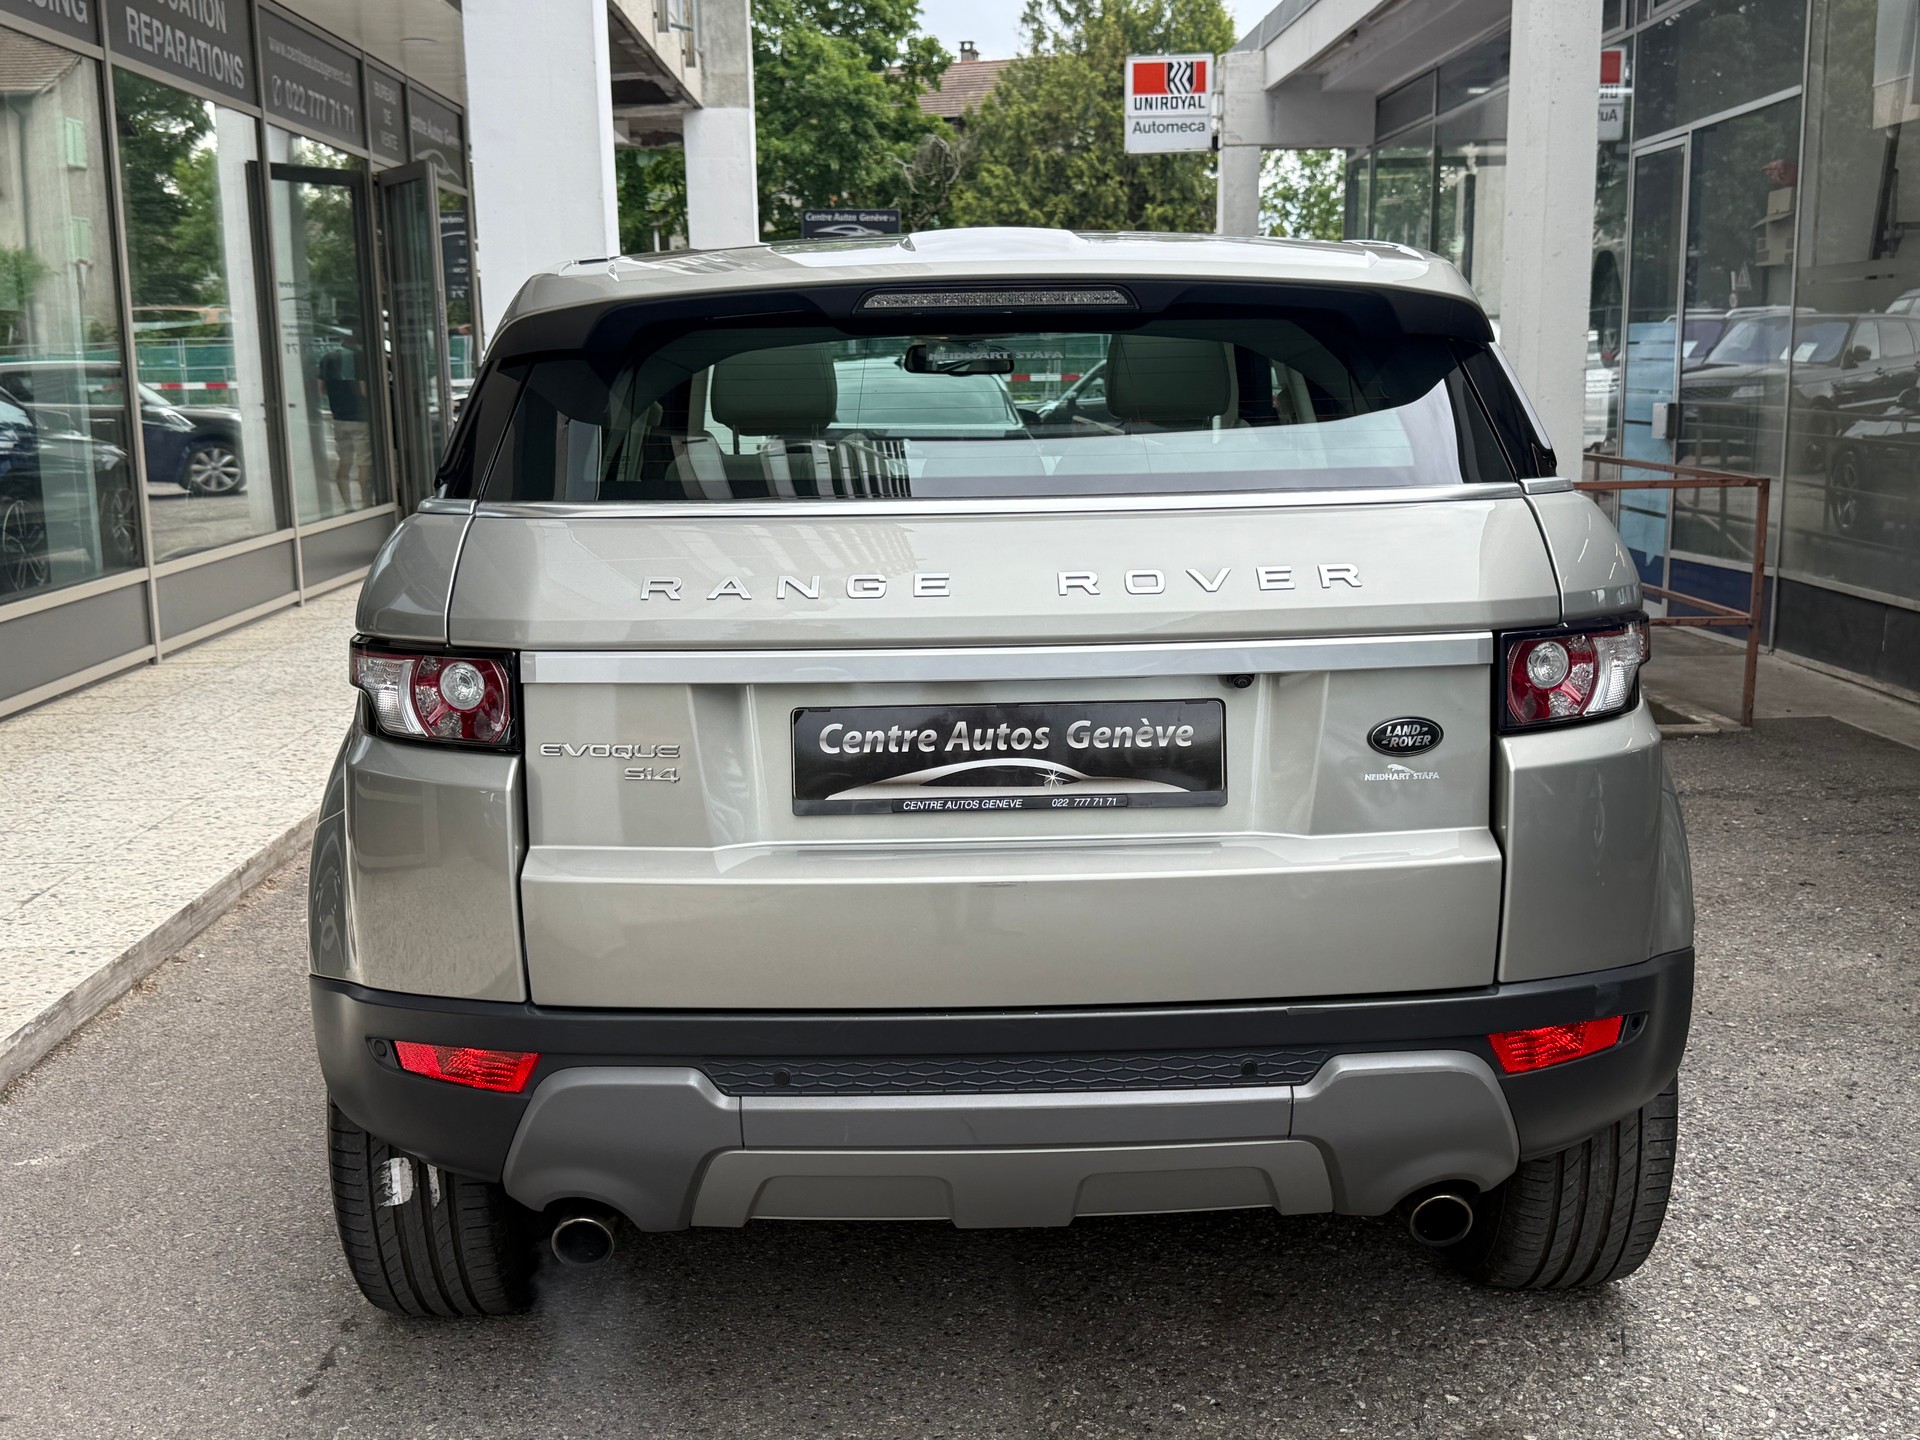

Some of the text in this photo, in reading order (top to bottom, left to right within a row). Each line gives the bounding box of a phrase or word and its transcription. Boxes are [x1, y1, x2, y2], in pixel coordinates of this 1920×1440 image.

[125, 6, 245, 90] REPARATIONS
[285, 79, 355, 133] 022 777 71 71
[1134, 95, 1206, 111] UNIROYAL
[1132, 121, 1206, 134] Automeca
[805, 211, 832, 222] Centre
[833, 211, 857, 222] Autos
[640, 563, 1363, 601] RANGE ROVER
[818, 718, 1195, 754] Centre Autos Genève
[1385, 724, 1421, 737] LAND
[1388, 735, 1432, 748] ROVER
[539, 743, 681, 760] EVOQUE
[623, 767, 681, 783] Si4
[1364, 772, 1411, 781] NEIDHART
[903, 797, 1117, 810] CENTRE AUTOS GENEVE 022 777 71 71
